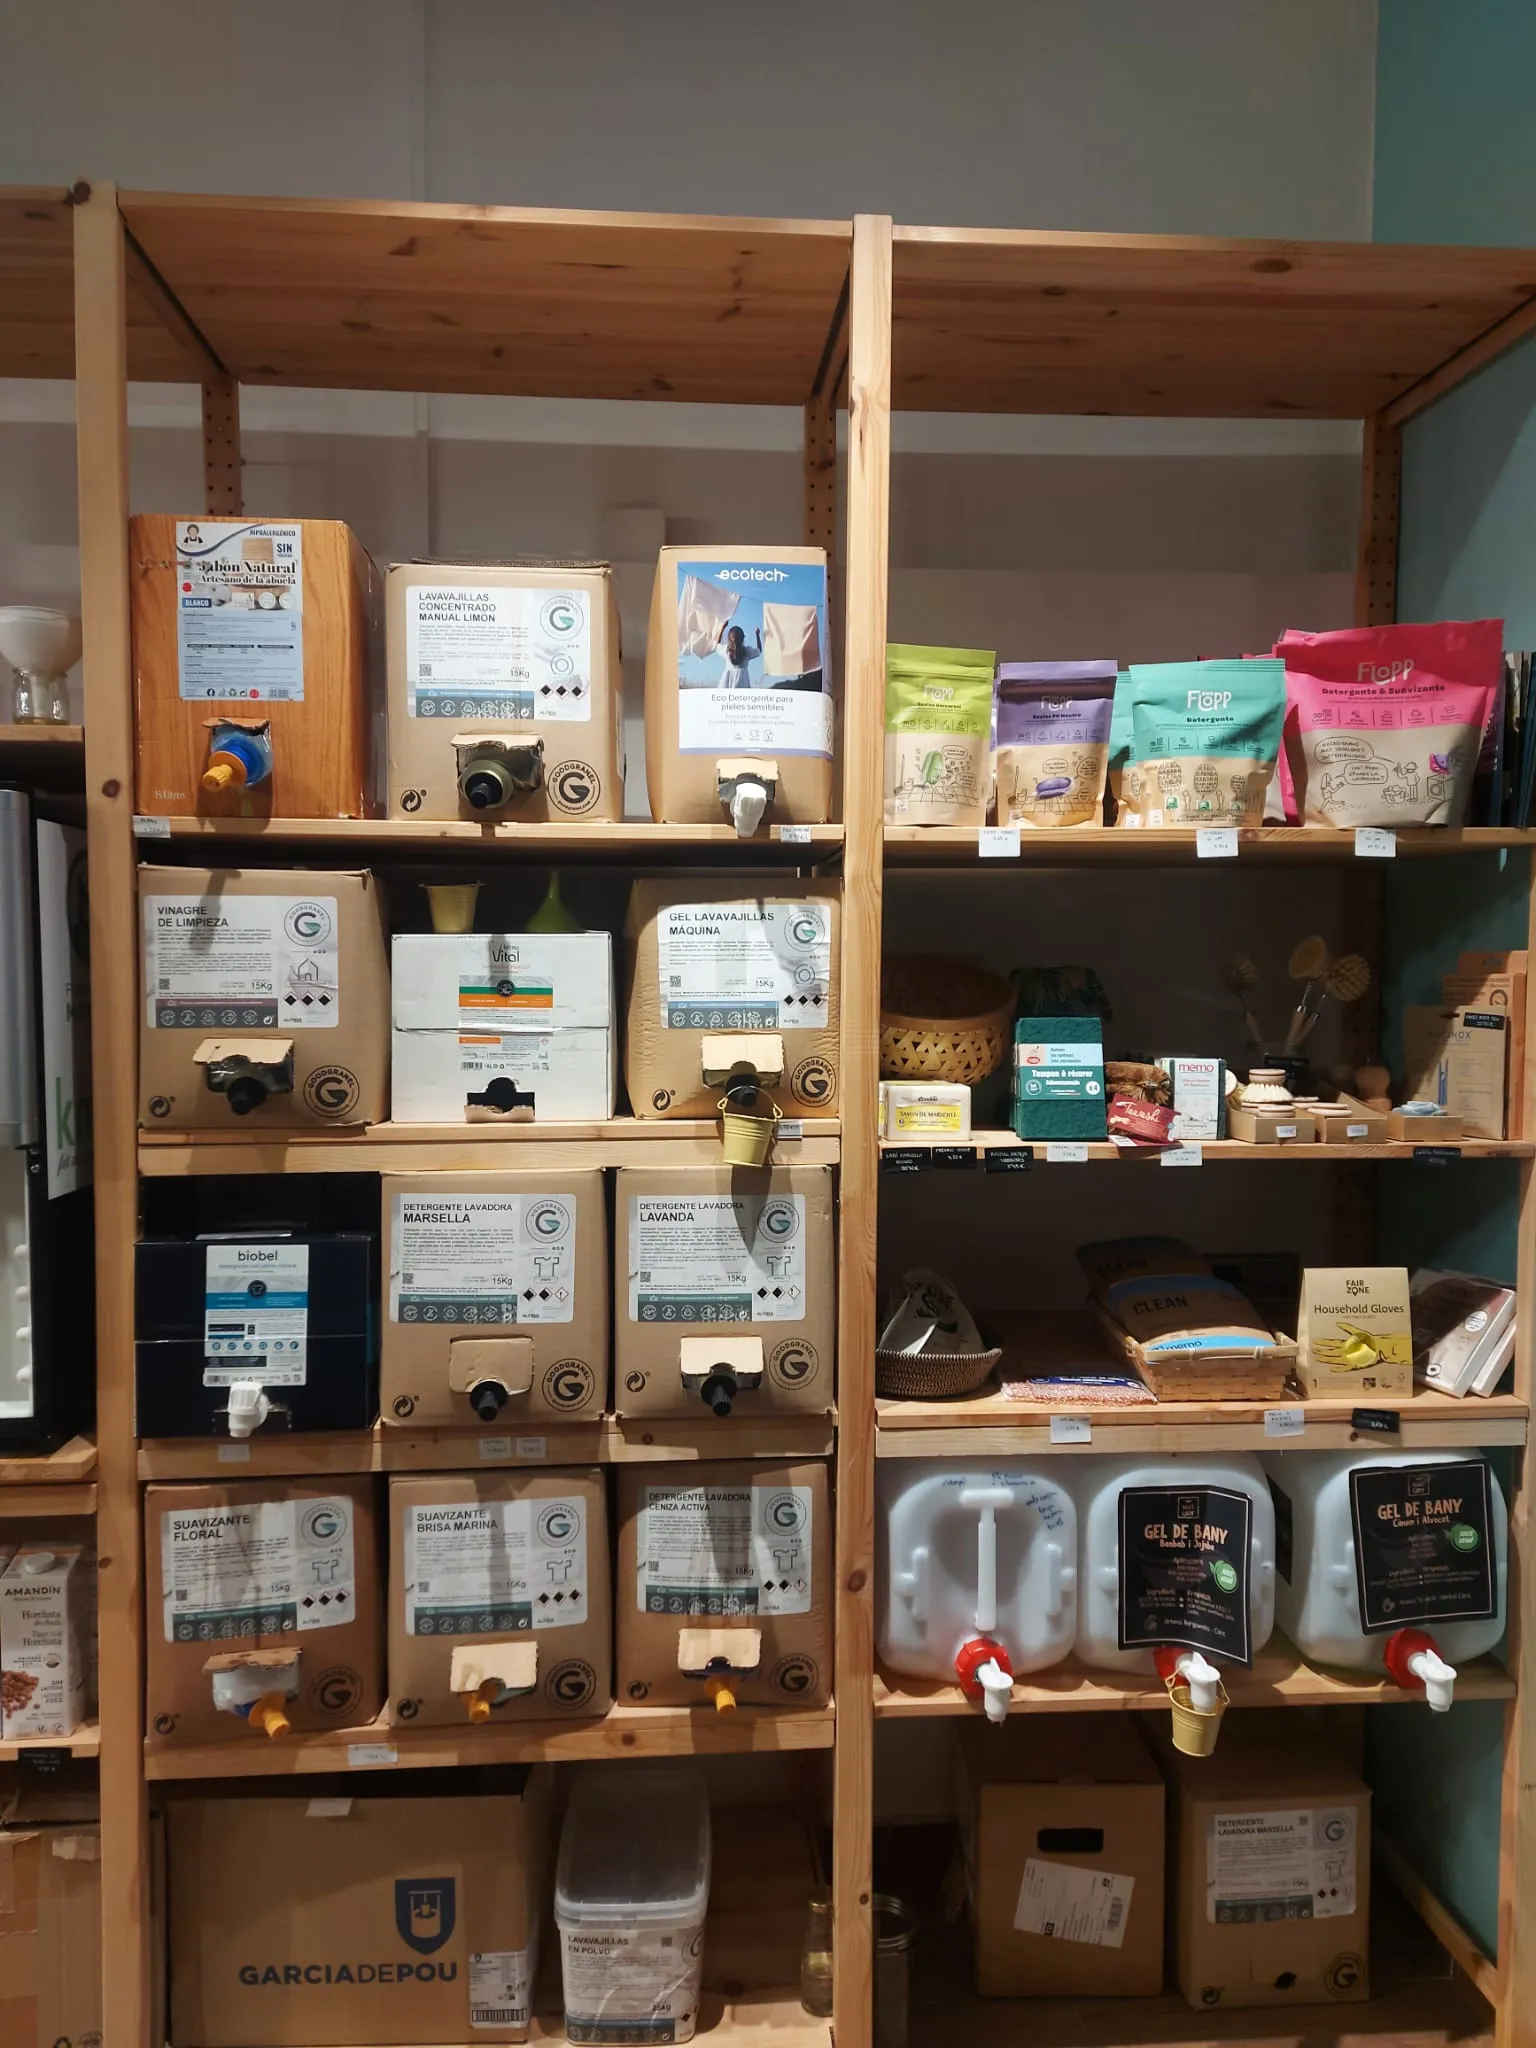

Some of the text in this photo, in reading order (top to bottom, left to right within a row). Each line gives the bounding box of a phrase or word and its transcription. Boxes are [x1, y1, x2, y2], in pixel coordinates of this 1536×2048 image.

[276, 543, 293, 553] SIN
[244, 560, 296, 574] Natural
[243, 575, 254, 584] de
[256, 575, 265, 584] la
[717, 567, 786, 583] ecotech
[186, 598, 209, 607] BLANCO
[419, 592, 489, 602] LAVAVAJILLAS
[419, 602, 497, 612] CONCENTRADO
[419, 612, 496, 623] MANUAL LIMÓN
[510, 669, 530, 679] 15Kg
[1358, 659, 1414, 686] Flopp
[1322, 687, 1377, 696] Detergente
[1388, 684, 1446, 694] Suavizante
[728, 694, 775, 703] Detergente
[1187, 690, 1232, 712] Flopp
[721, 703, 785, 712] pieles sensibles
[552, 762, 596, 785] GOODGRANEL
[158, 905, 209, 916] VINAGRE
[669, 912, 775, 922] GEL LAVAVAJILLAS
[158, 918, 229, 928] DE LIMPIEZA
[669, 924, 721, 937] MÁQUINA
[492, 950, 520, 963] Vital
[250, 982, 273, 992] 15Kg
[754, 978, 775, 989] 15Kg
[795, 1058, 834, 1080] GOODGRANEL
[1179, 1063, 1215, 1073] memo
[307, 1067, 356, 1090] GOODGRANEL
[403, 1203, 513, 1212] DETERGENTE LAVADORA
[640, 1202, 744, 1211] DETERGENTE LAVADORA
[403, 1213, 471, 1224] MARSELLA
[640, 1212, 695, 1223] LAVANDA
[238, 1250, 278, 1262] biobel
[492, 1276, 513, 1286] 15Kg
[727, 1274, 747, 1283] 15Kg
[1346, 1279, 1365, 1287] FAIR
[1346, 1287, 1370, 1297] ZONE
[1133, 1296, 1190, 1316] CLEAN
[1314, 1303, 1404, 1314] Household Gloves
[772, 1341, 815, 1362] GOODGRANEL
[547, 1361, 591, 1383] GOODGRANEL
[649, 1492, 751, 1502] DETERGENTE LAVADORA
[649, 1503, 711, 1512] CENIZA ACTIVA
[1377, 1498, 1463, 1521] GEL DE BANY
[417, 1509, 487, 1522] SUAVIZANTE
[1422, 1515, 1451, 1525] Alvocat
[173, 1514, 251, 1531] SUAVIZANTE
[417, 1519, 499, 1533] BRISA MARINA
[173, 1529, 224, 1543] FLORAL
[1144, 1523, 1229, 1545] GEL DE BANY
[1159, 1539, 1186, 1549] Baobab
[5, 1586, 61, 1597] AMANDÍN
[1218, 1818, 1265, 1828] DETERGENTE
[1218, 1825, 1294, 1837] LAVADORA MARSELLA
[568, 1935, 629, 1946] LAVAVAJILLAS
[568, 1945, 611, 1956] EN POLVO
[238, 1961, 458, 1987] GARCIADEPOU
